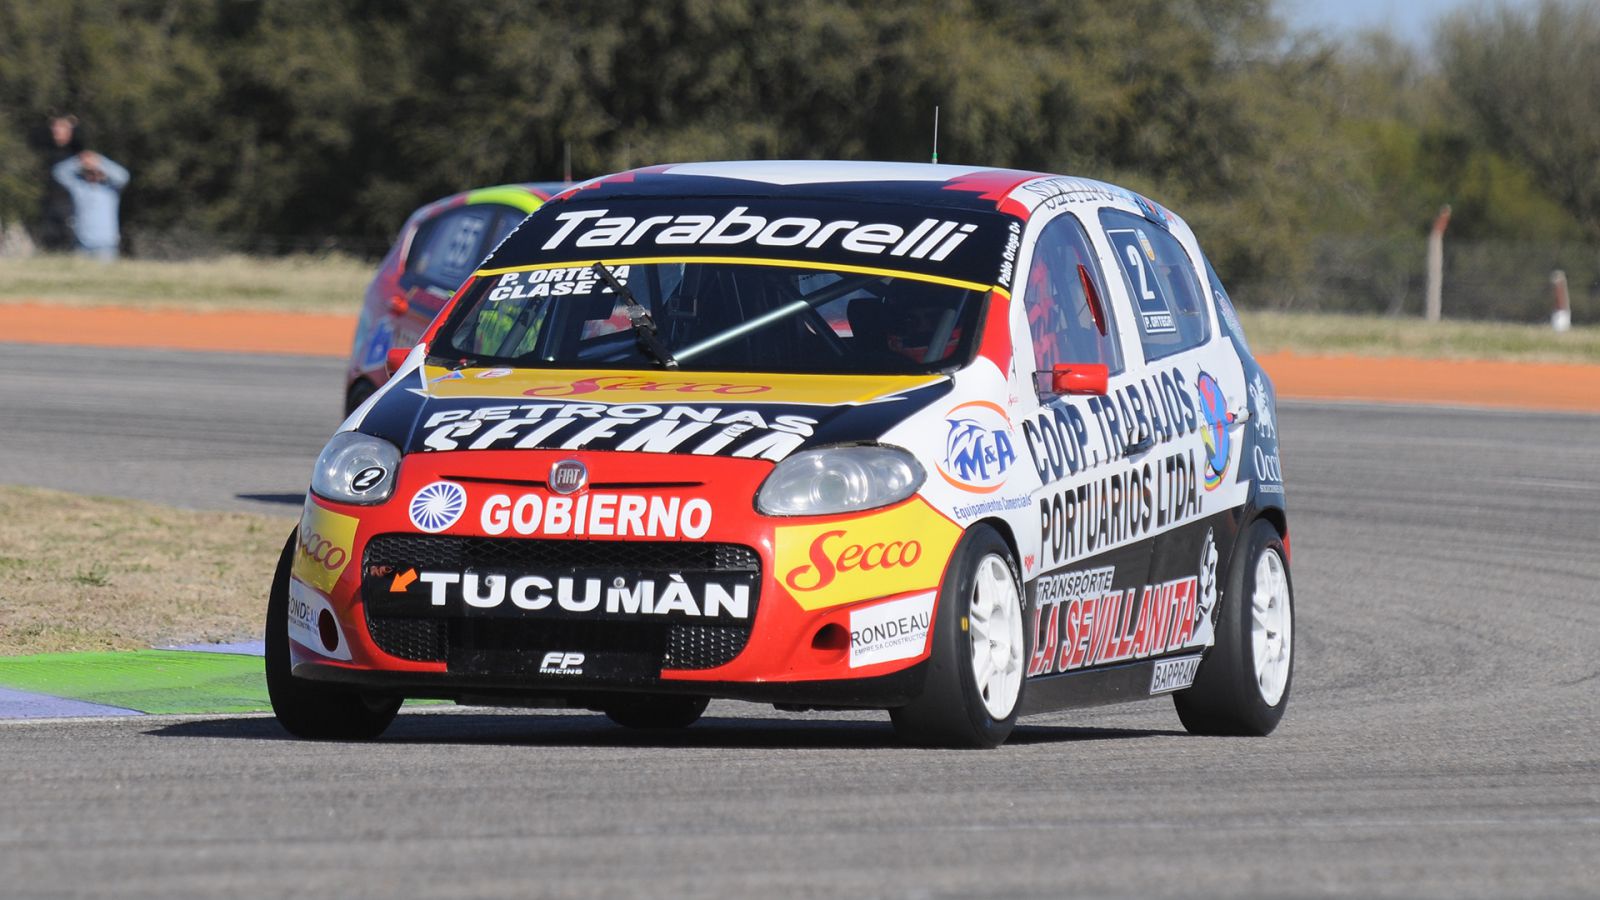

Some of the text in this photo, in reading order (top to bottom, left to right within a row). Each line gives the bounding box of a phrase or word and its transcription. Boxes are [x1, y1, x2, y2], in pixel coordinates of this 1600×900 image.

[541, 207, 978, 261] Taraborelli
[1002, 233, 1019, 261] Ortega
[498, 273, 519, 286] P.
[998, 261, 1012, 287] Pablo
[1127, 245, 1155, 300] 2
[488, 280, 596, 300] CLASE
[523, 376, 772, 396] Secco
[424, 404, 819, 437] PETRONAS
[954, 430, 1017, 481] M&A
[355, 469, 381, 487] 2
[557, 468, 580, 484] FIAT
[481, 494, 712, 539] GOBIERNO
[1040, 448, 1202, 568] PORTUARIOS LTDA.
[786, 530, 921, 591] Secco
[1038, 569, 1113, 601] TRANSPORTE
[851, 611, 929, 648] RONDEAU
[1027, 605, 1059, 677] LA
[1058, 576, 1197, 672] SEVILLANITA
[540, 651, 586, 669] FP
[854, 643, 884, 656] EMPRESA
